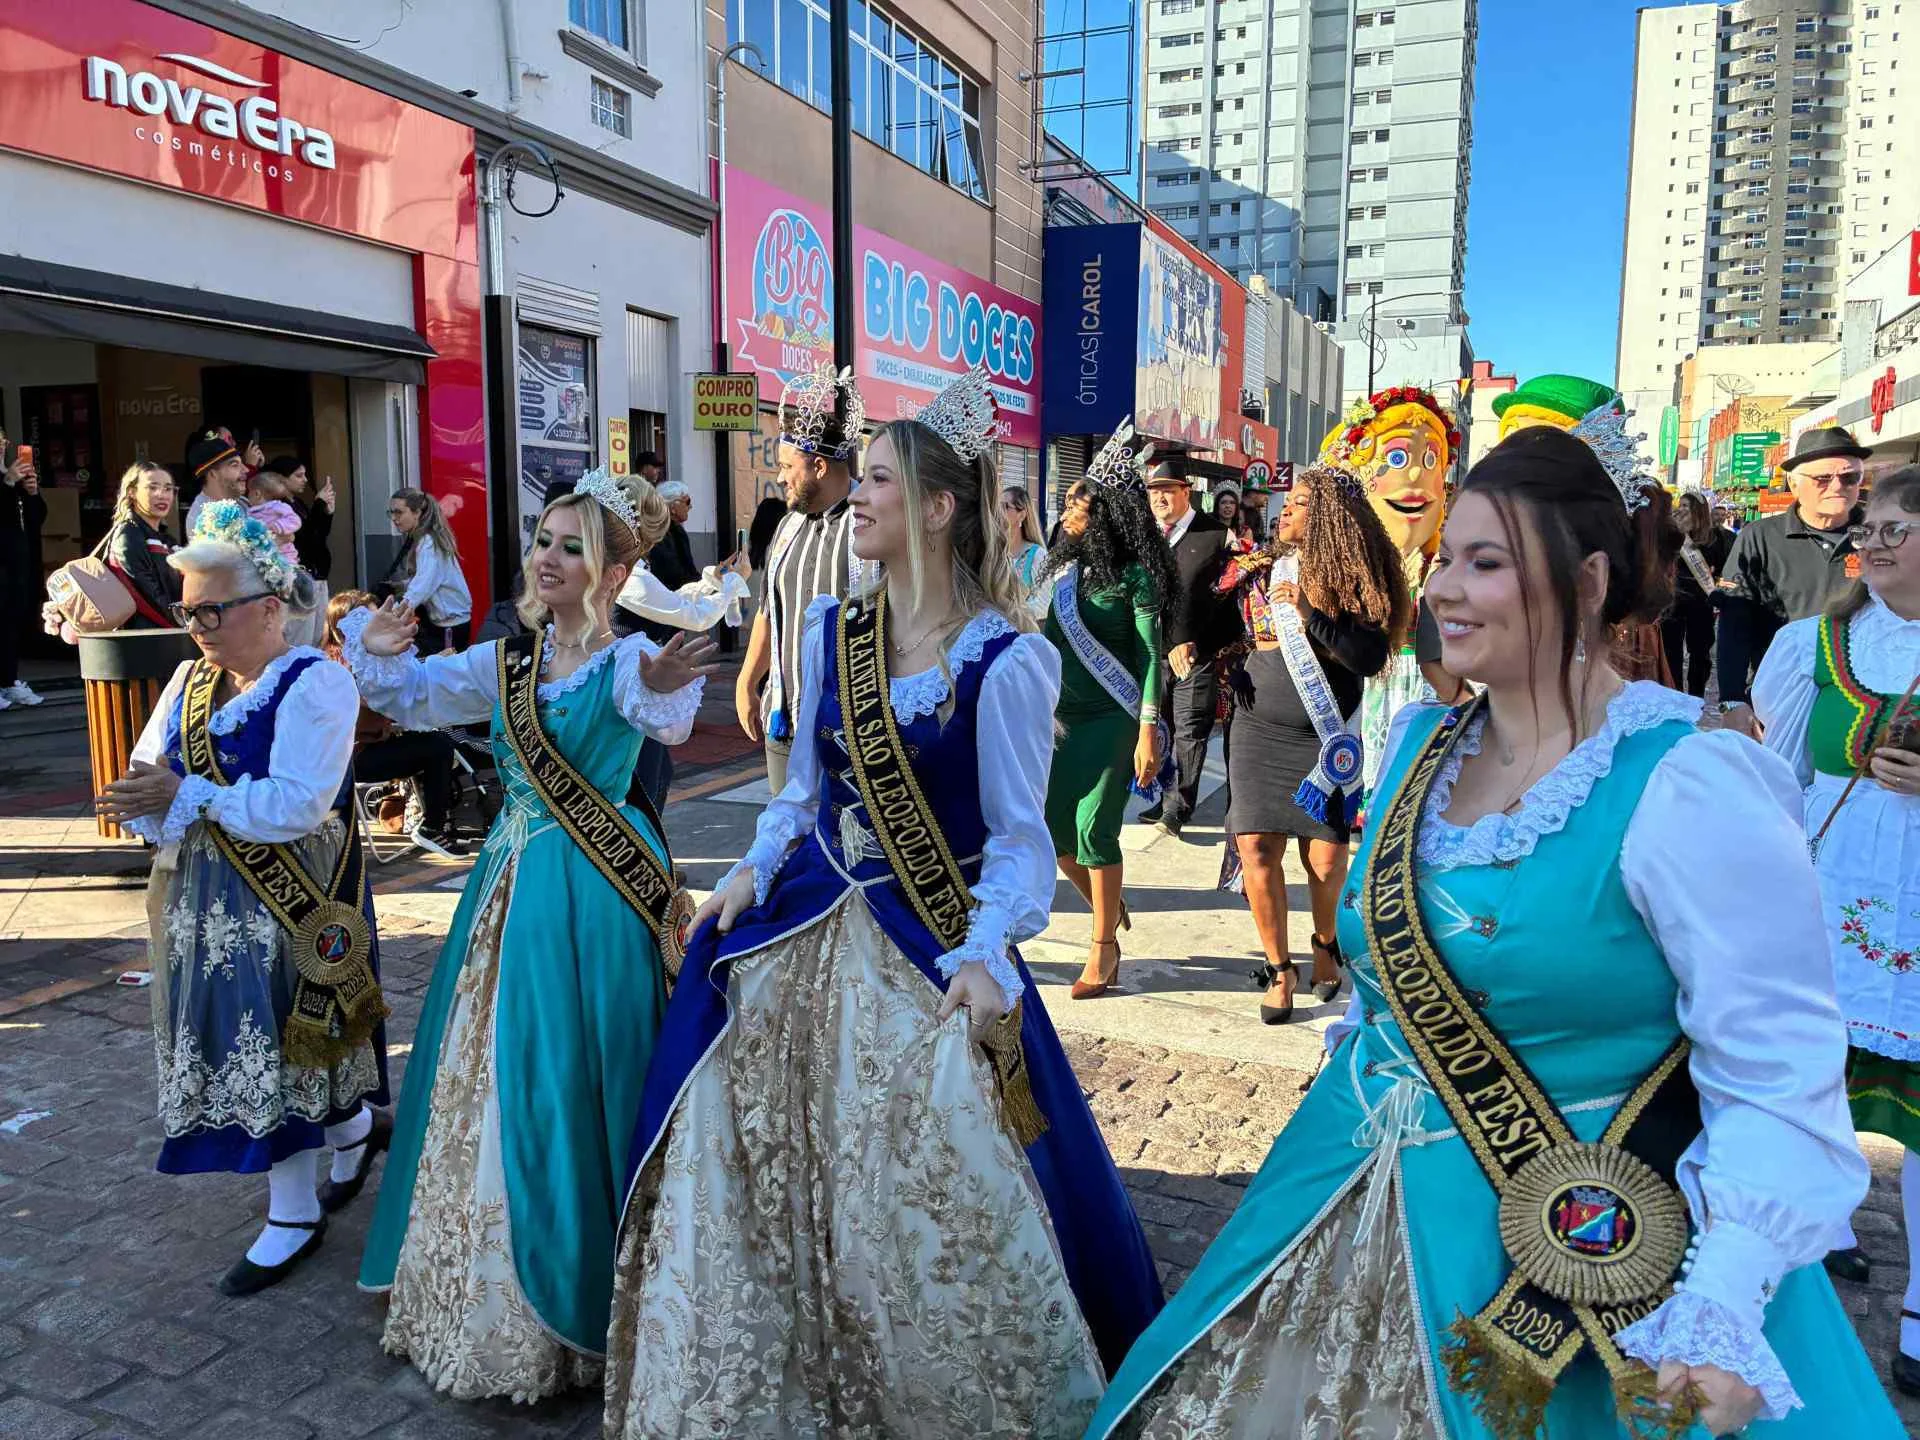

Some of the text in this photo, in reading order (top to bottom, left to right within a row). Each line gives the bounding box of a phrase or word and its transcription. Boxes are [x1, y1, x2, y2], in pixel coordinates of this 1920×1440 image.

[80, 56, 336, 169] novaEra
[135, 126, 294, 183] cosméticos
[764, 214, 829, 332] Big
[864, 249, 1034, 385] BIG DOCES
[782, 344, 812, 373] DOCES
[119, 393, 200, 416] novaEra
[697, 380, 753, 397] COMPRO
[698, 402, 753, 417] OURO
[1251, 466, 1266, 479] 30
[1104, 667, 1139, 704] LEOPOLDO
[509, 690, 541, 765] PRINCESA
[563, 790, 636, 868] LEOPOLDO
[625, 860, 668, 907] FEST
[849, 629, 876, 717] RAINHA
[871, 771, 945, 887] LEOPOLDO
[925, 884, 968, 947] FEST
[256, 862, 308, 915] FEST
[1380, 930, 1493, 1076] LEOPOLDO
[1464, 1073, 1555, 1166] FEST
[1501, 1300, 1563, 1352] 2026
